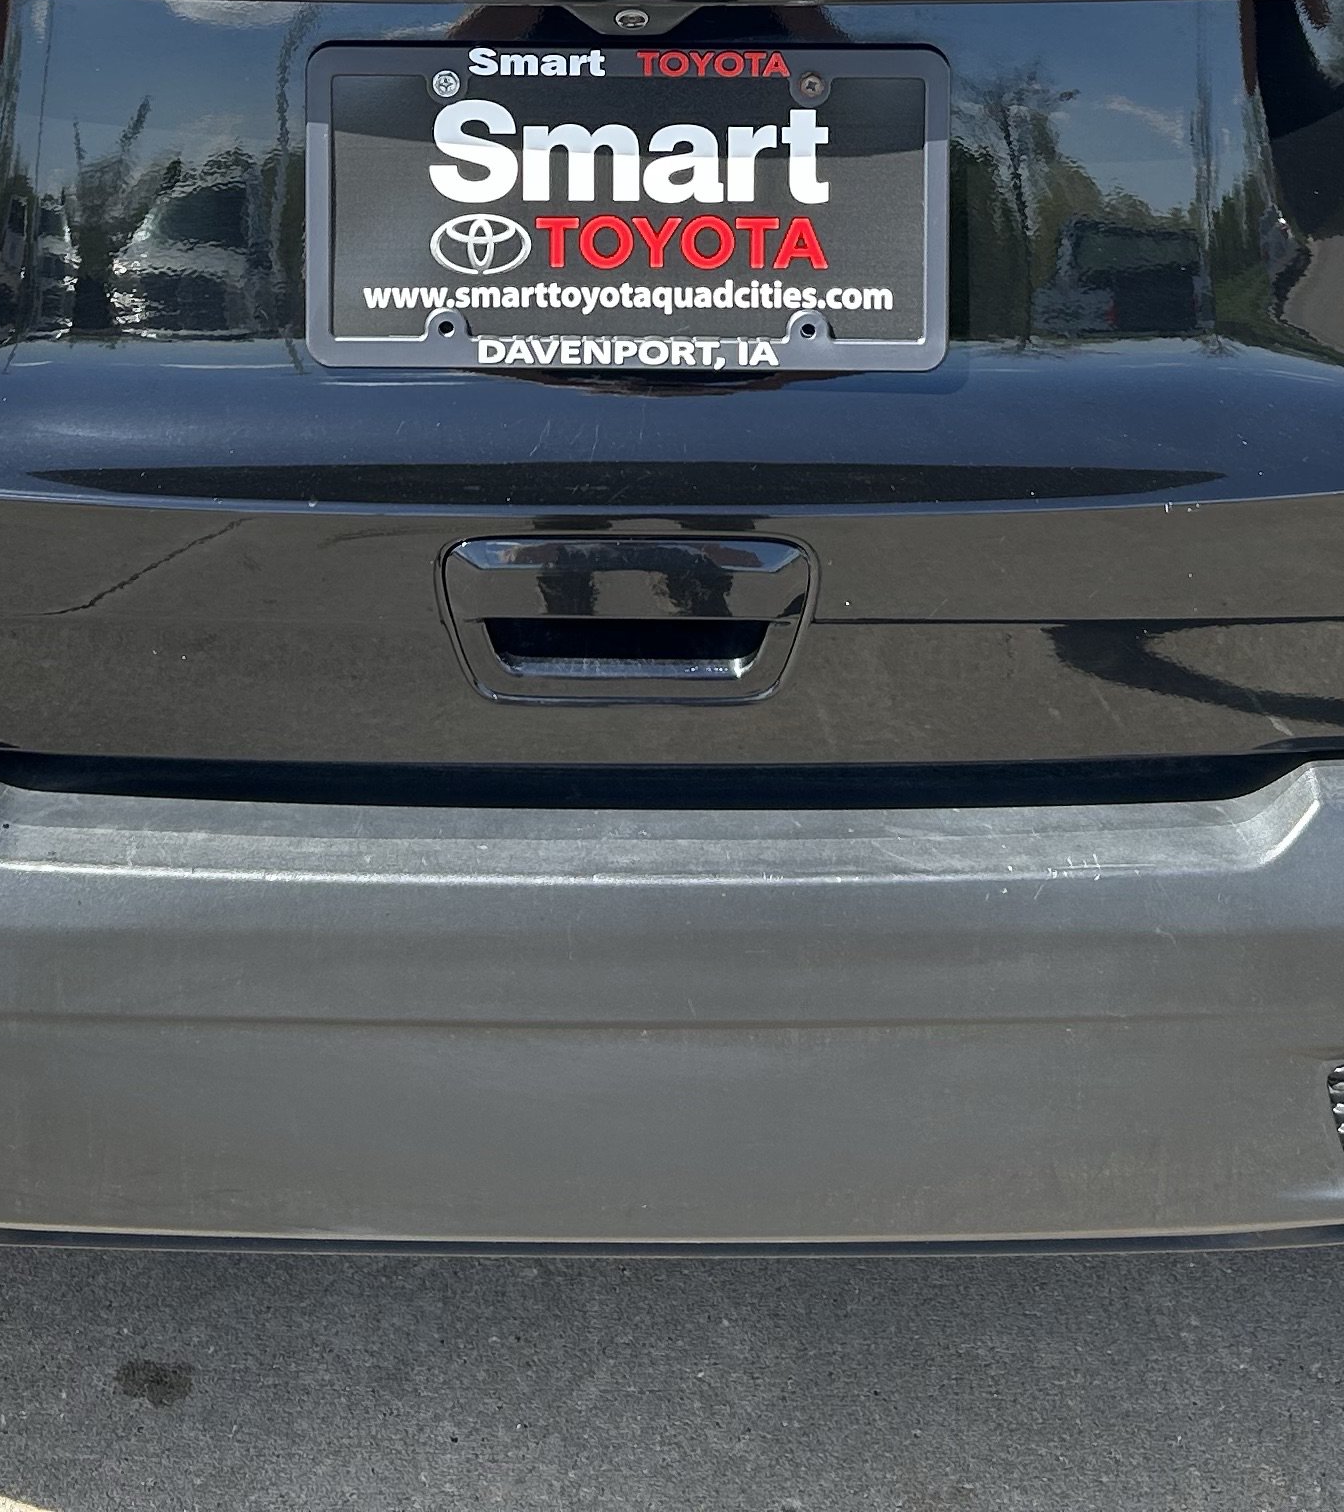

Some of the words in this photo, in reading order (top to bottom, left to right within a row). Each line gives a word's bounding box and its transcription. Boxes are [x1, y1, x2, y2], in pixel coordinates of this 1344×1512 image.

[467, 47, 606, 78] Smart
[636, 50, 791, 78] TOYOTA
[429, 99, 830, 205] Smart
[535, 216, 829, 271] TOYOTA
[363, 280, 894, 315] www.smarttoyotaquadcities.com
[476, 339, 727, 370] DAVENPORT,
[737, 339, 779, 367] IA
